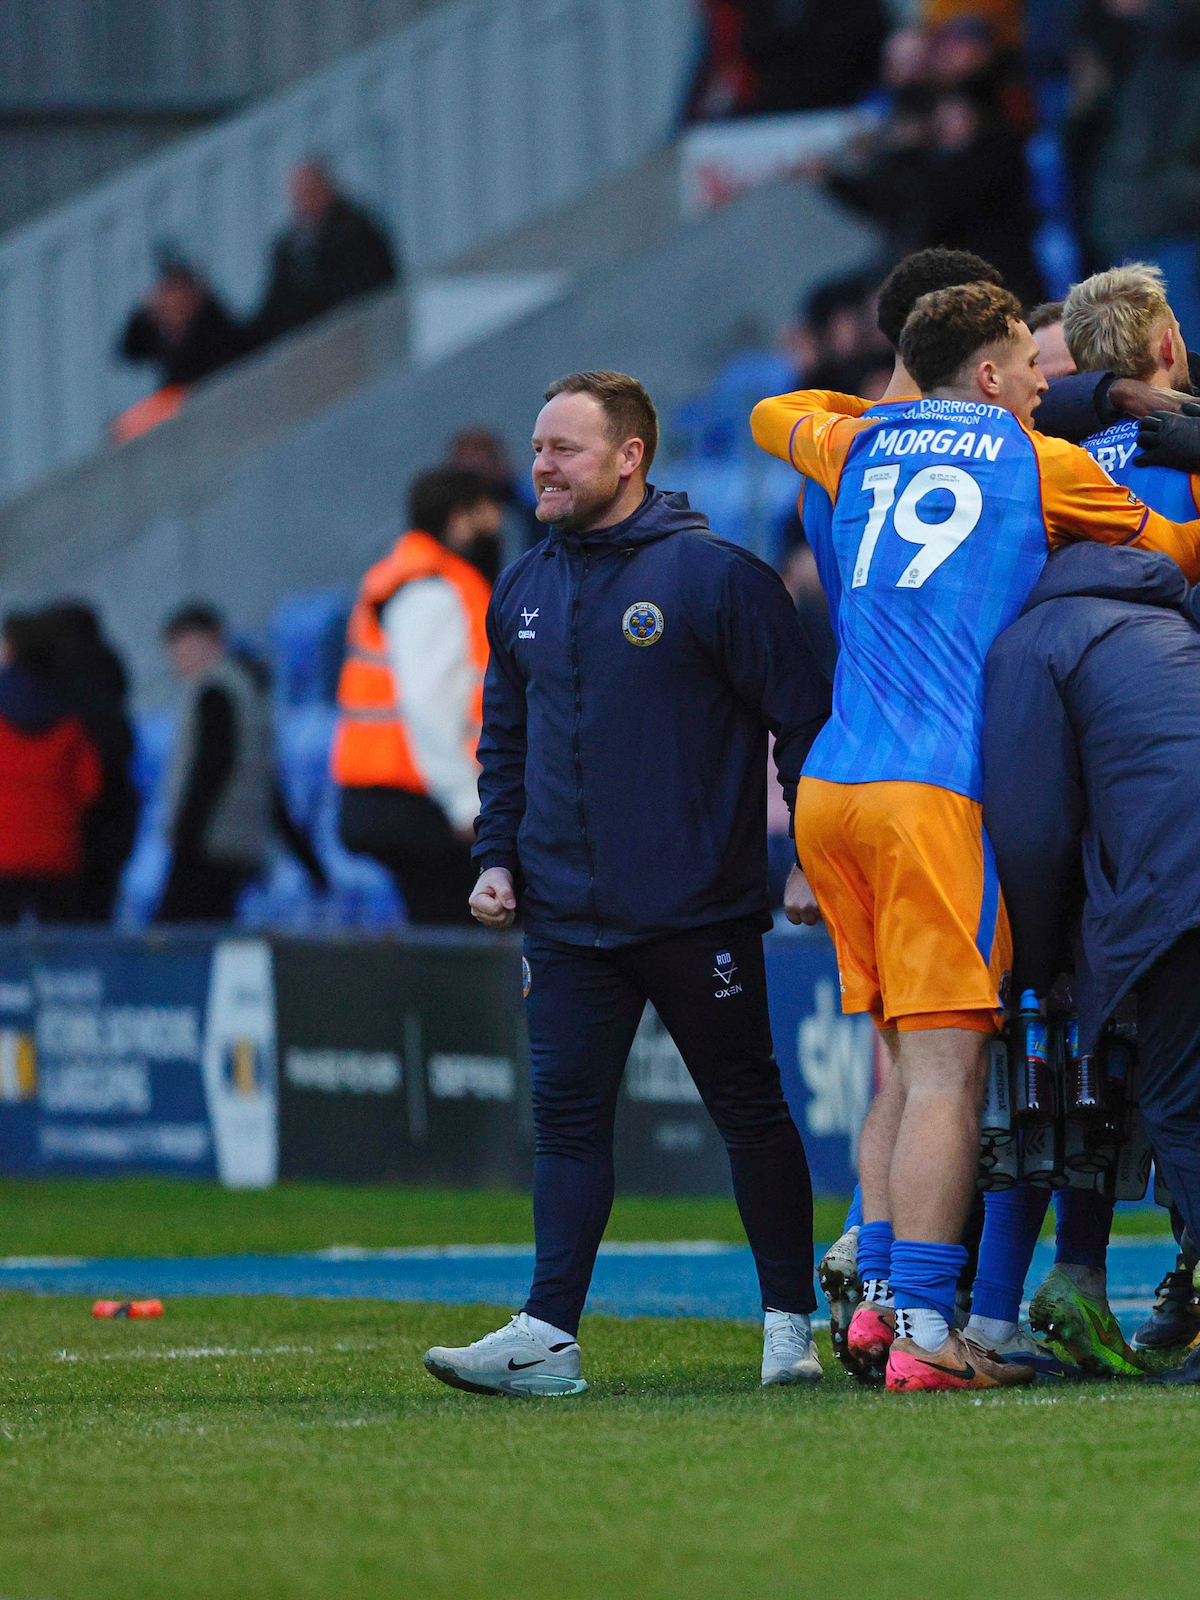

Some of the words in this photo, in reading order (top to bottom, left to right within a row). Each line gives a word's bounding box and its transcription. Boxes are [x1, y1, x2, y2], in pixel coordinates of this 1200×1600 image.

[920, 399, 1007, 420] DORRICOTT
[868, 429, 1004, 462] MORGAN
[851, 464, 983, 589] 19
[714, 983, 743, 998] OXEN
